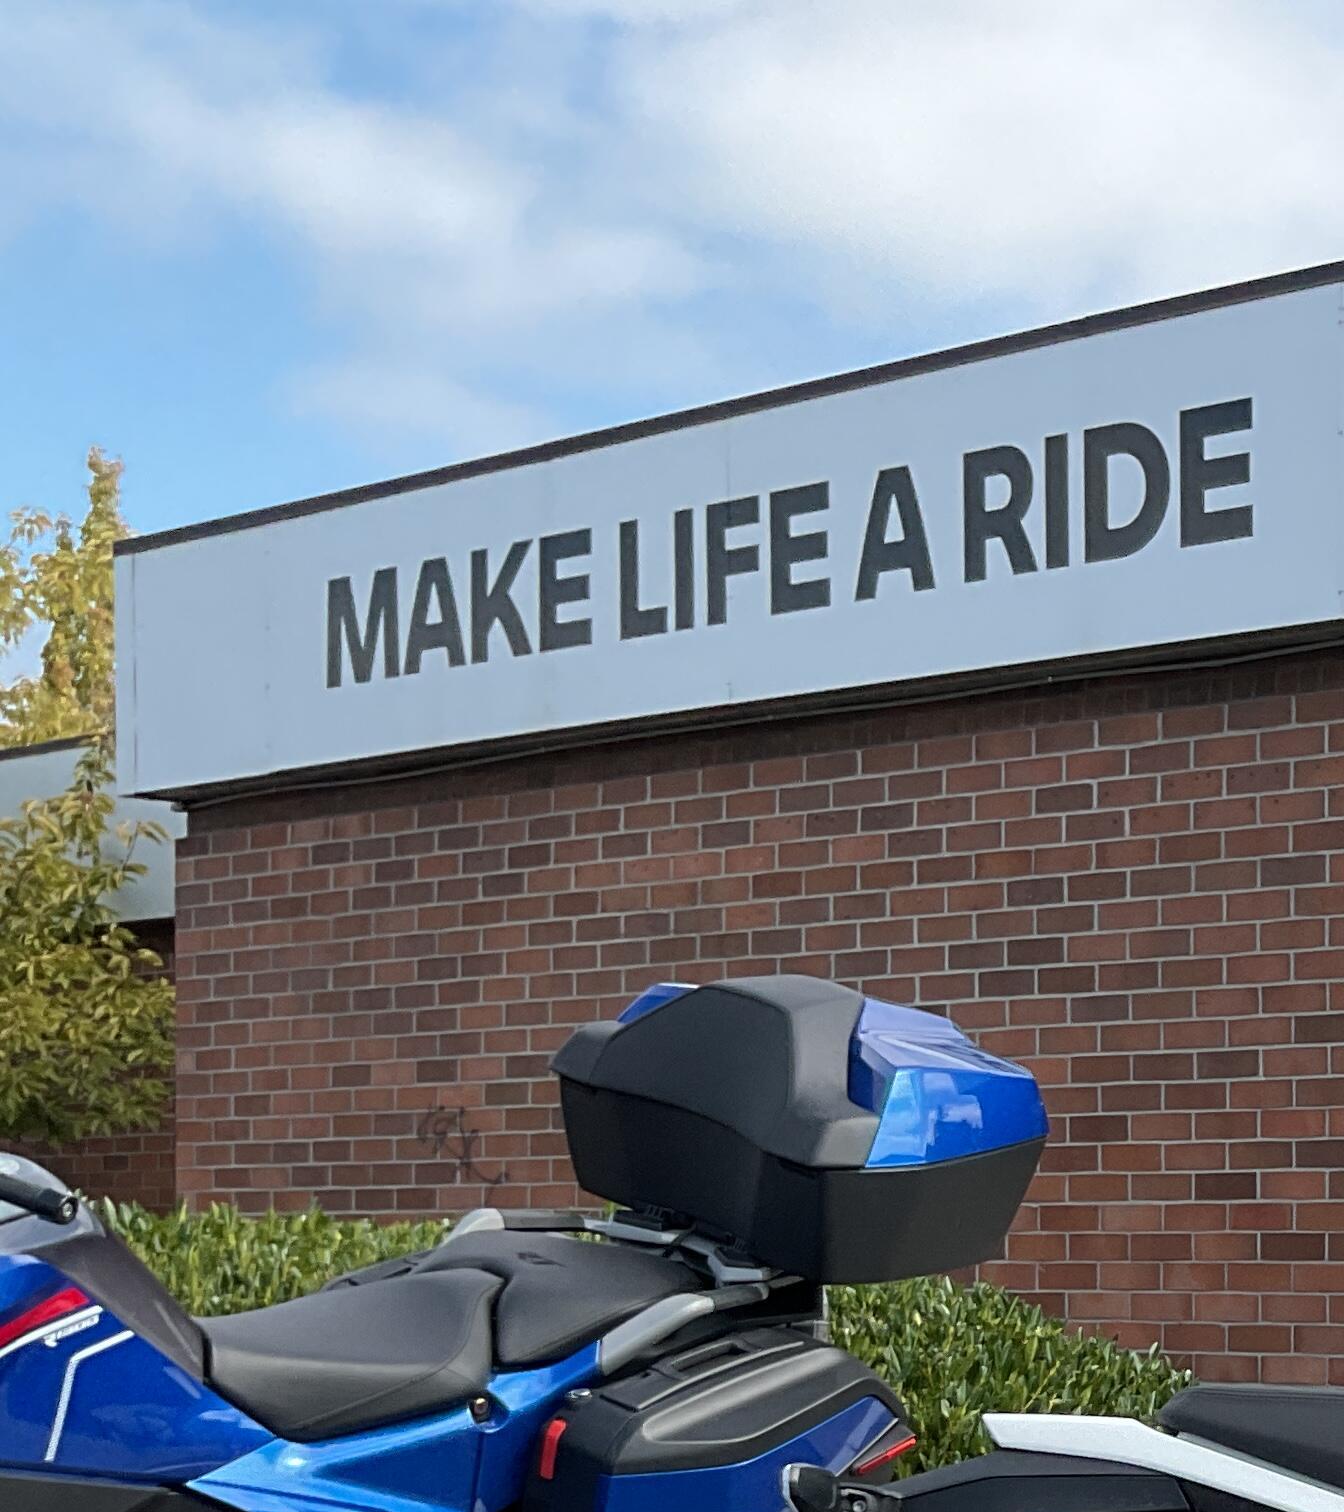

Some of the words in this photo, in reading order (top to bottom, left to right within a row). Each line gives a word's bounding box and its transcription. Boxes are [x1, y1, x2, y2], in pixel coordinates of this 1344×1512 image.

[326, 528, 593, 688] MAKE
[619, 480, 831, 641] LIFE
[854, 464, 936, 601] A
[963, 396, 1254, 584] RIDE
